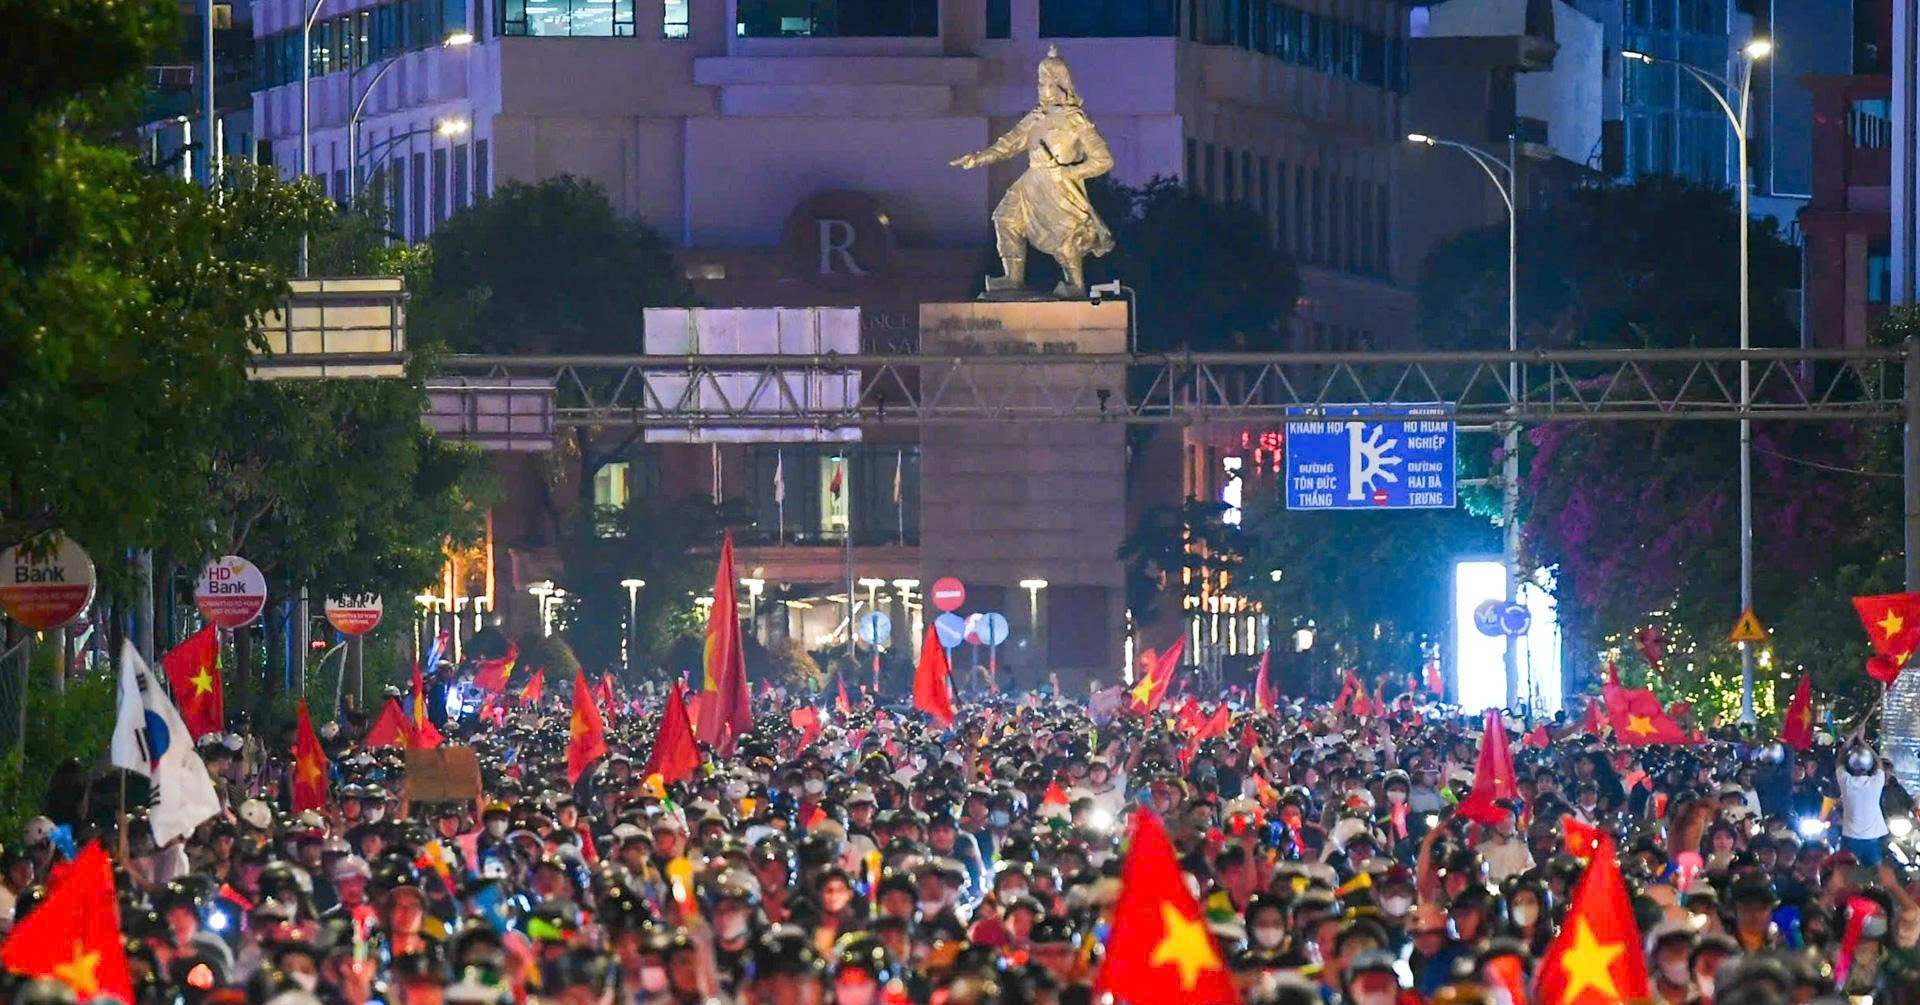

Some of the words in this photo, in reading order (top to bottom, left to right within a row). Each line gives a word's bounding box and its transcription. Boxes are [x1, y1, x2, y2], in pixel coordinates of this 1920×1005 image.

[816, 219, 867, 275] R
[1407, 434, 1446, 452] NGHIỆP
[1293, 475, 1314, 490] TÔN
[1407, 475, 1426, 489] HAI
[1428, 473, 1442, 489] BÀ
[15, 566, 65, 583] Bank
[208, 567, 231, 580] HD
[208, 580, 246, 594] Bank
[338, 595, 366, 608] Bank
